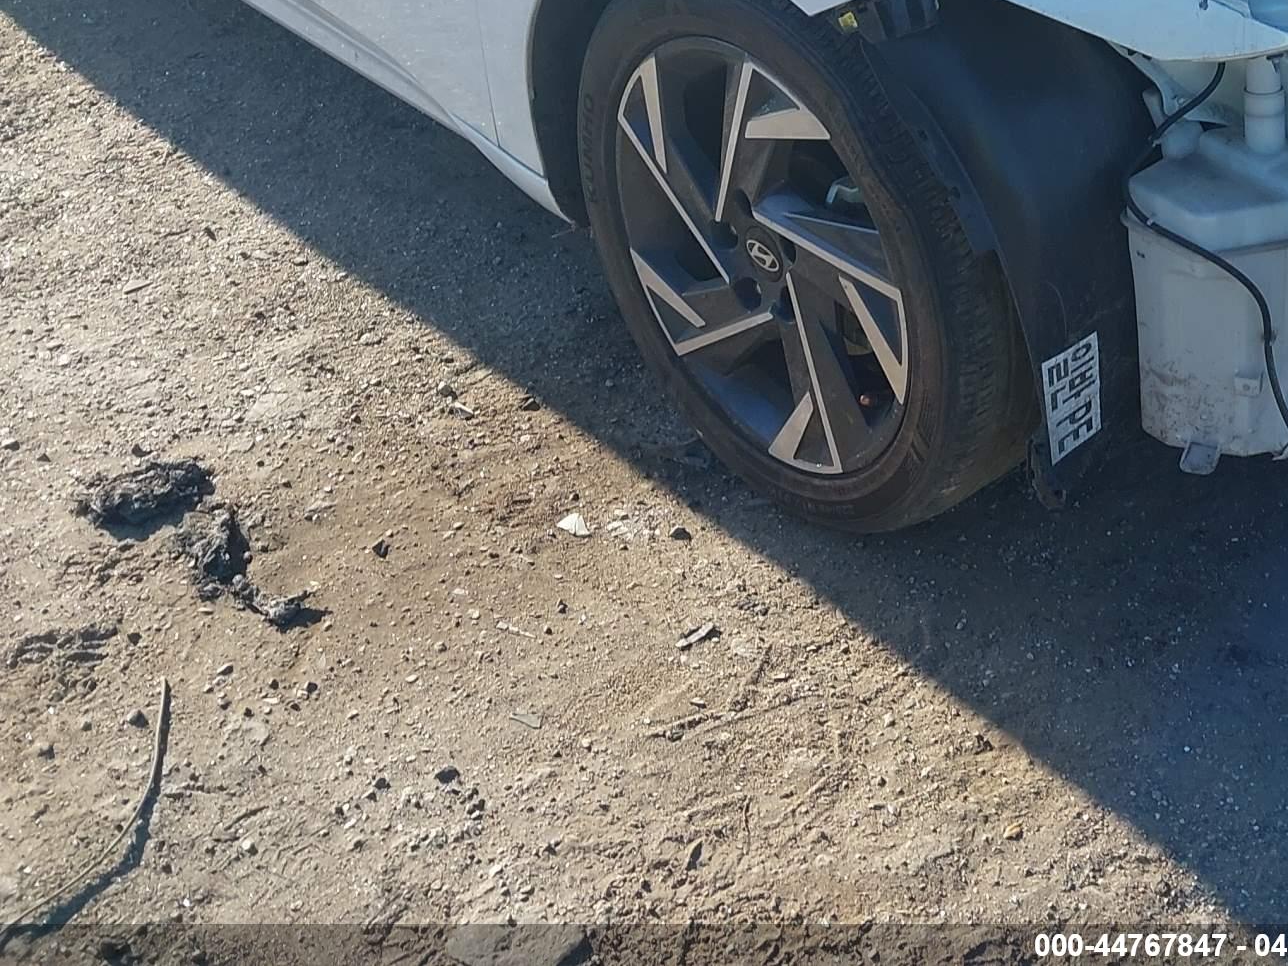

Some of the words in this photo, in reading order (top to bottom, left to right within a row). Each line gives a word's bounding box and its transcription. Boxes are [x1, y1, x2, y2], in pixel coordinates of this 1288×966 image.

[582, 93, 596, 203] KUMHO
[1047, 342, 1097, 412] 일반
[1055, 398, 1094, 455] PE
